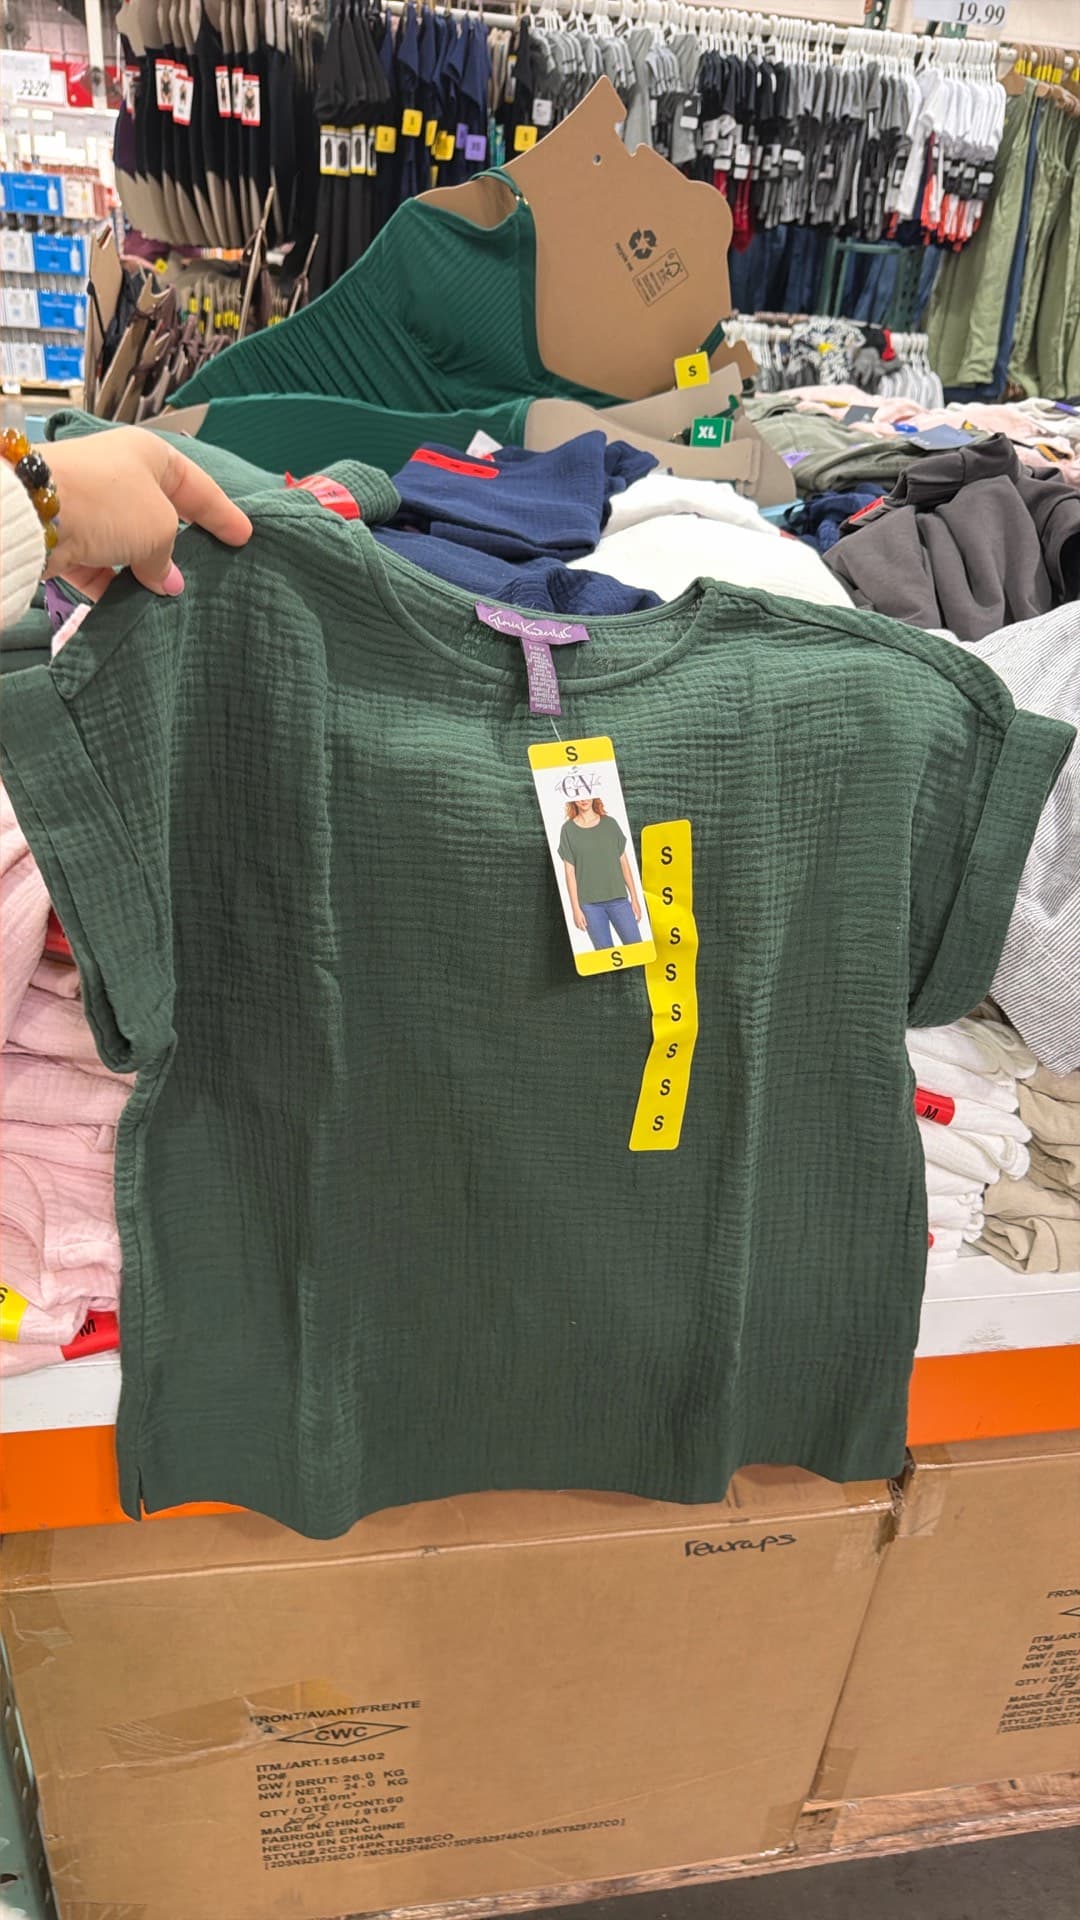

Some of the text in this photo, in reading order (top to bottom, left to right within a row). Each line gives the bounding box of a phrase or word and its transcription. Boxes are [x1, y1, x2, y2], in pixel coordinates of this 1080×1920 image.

[957, 1, 1006, 26] 19.99
[688, 365, 698, 377] S
[697, 425, 717, 440] XL
[565, 745, 579, 762] S
[660, 846, 673, 866] S
[661, 886, 674, 906] S
[669, 926, 682, 945] S
[610, 951, 624, 968] S
[665, 963, 677, 982] S
[670, 1003, 682, 1022] S
[666, 1042, 679, 1059] S
[659, 1078, 671, 1096] S
[921, 1104, 940, 1121] M
[652, 1114, 665, 1131] S
[79, 1318, 97, 1337] M
[684, 1533, 798, 1557] rewraps
[315, 1726, 368, 1741] CWC
[256, 1772, 288, 1782] PO#
[257, 1782, 284, 1791] GW
[295, 1776, 339, 1787] BRUT:
[343, 1771, 374, 1783] 26.0
[384, 1769, 406, 1778] KG
[258, 1791, 283, 1800] NW
[295, 1786, 327, 1797] NET:
[387, 1777, 408, 1787] KG
[259, 1808, 289, 1818] QTY
[260, 1824, 305, 1835] MADE
[307, 1823, 321, 1831] IN
[325, 1817, 370, 1828] CHINA
[339, 1827, 359, 1836] EN
[362, 1822, 406, 1834] CHINE
[261, 1833, 384, 1853] HECHO EN CHINA
[262, 1849, 316, 1862] STYLE#
